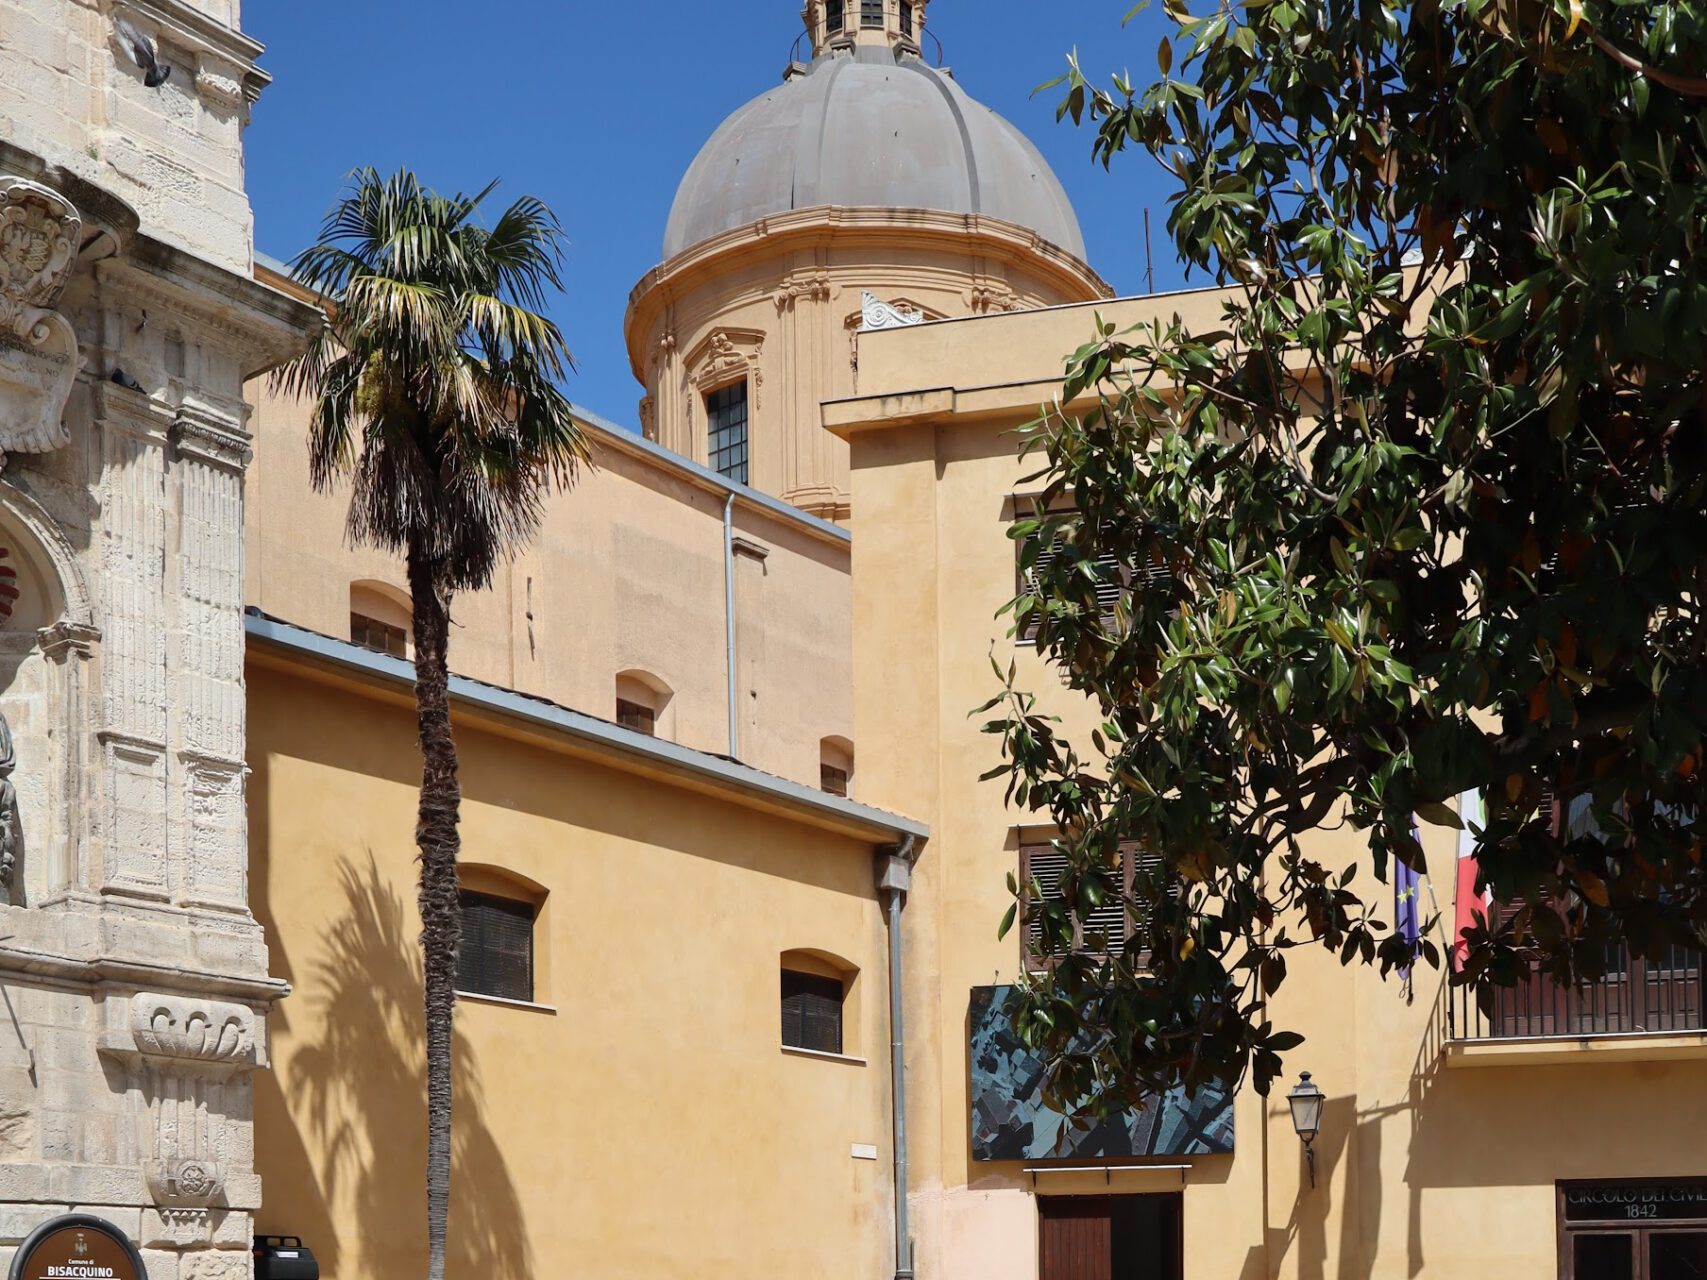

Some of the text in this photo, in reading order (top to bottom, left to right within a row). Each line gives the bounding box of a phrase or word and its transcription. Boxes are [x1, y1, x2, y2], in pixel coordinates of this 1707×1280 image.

[1568, 1188, 1637, 1203] CIRCOLO
[1642, 1187, 1664, 1202] DEI
[1624, 1204, 1657, 1218] 1842
[47, 1266, 113, 1278] BISACQUINO
